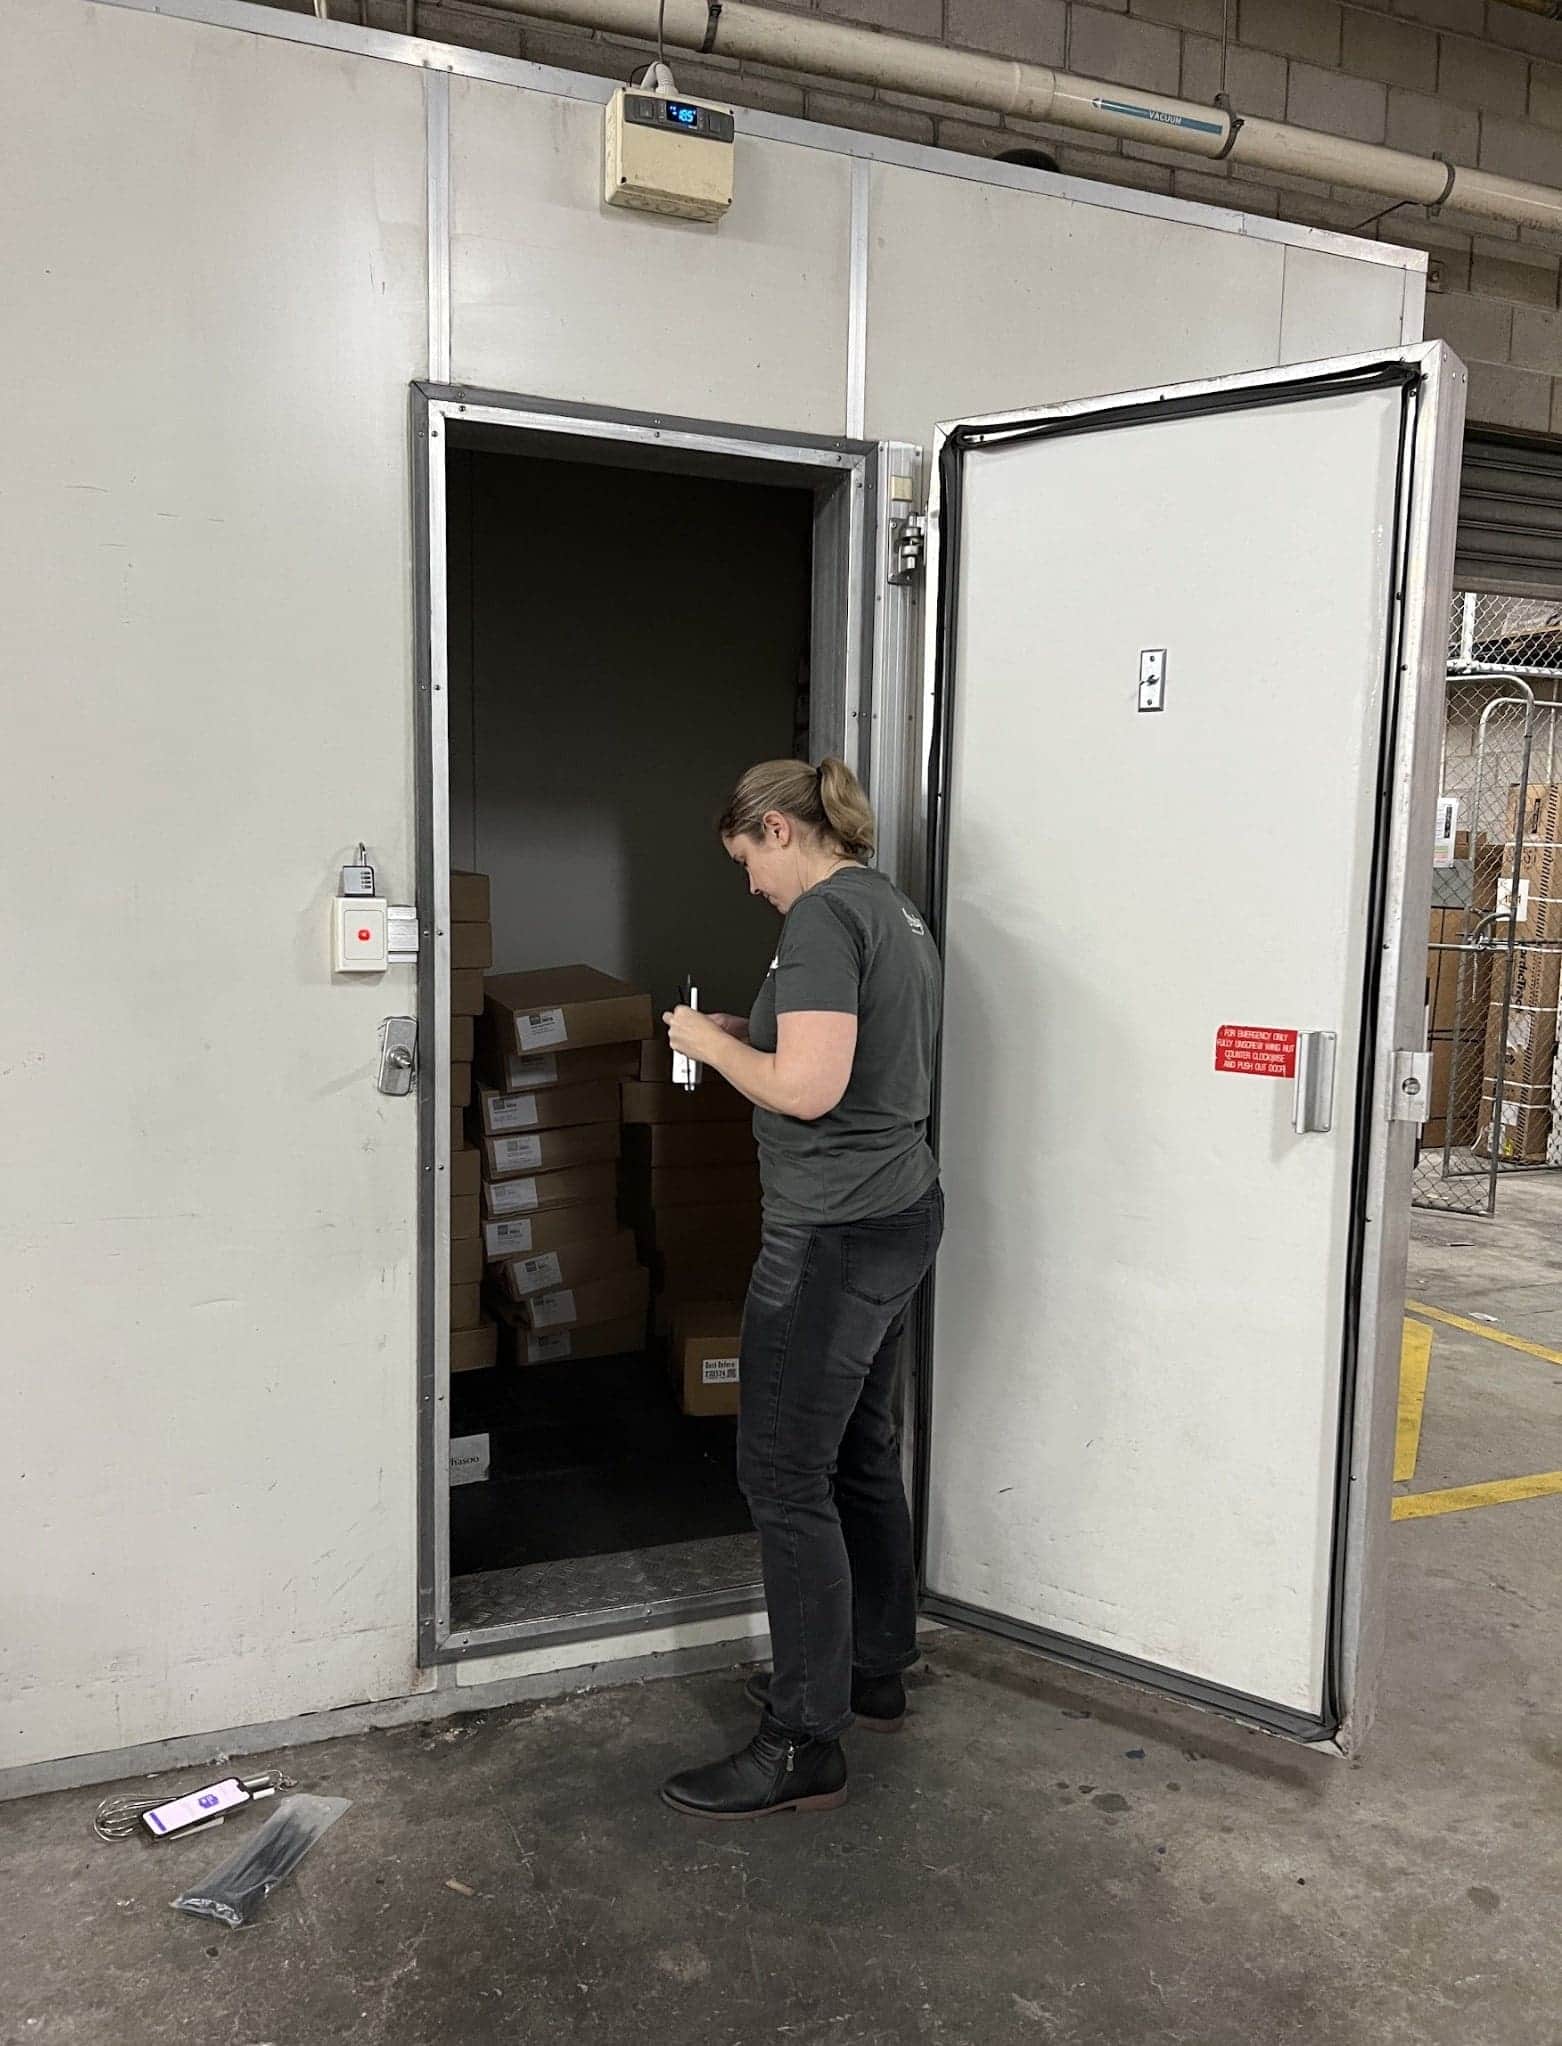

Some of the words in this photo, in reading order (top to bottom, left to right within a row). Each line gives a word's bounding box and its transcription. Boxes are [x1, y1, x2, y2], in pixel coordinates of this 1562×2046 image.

[1149, 110, 1182, 125] VACUUM
[1223, 1028, 1236, 1037] FOR
[1237, 1030, 1272, 1040] EMERGENCY
[1272, 1033, 1289, 1042] ONLY
[1224, 1050, 1251, 1059] COUNTER
[1252, 1052, 1286, 1062] CLOCKWISE
[1223, 1060, 1236, 1068] AND
[1237, 1061, 1253, 1070] PUSH
[1254, 1063, 1267, 1071] OUT
[1268, 1064, 1287, 1073] DOOR
